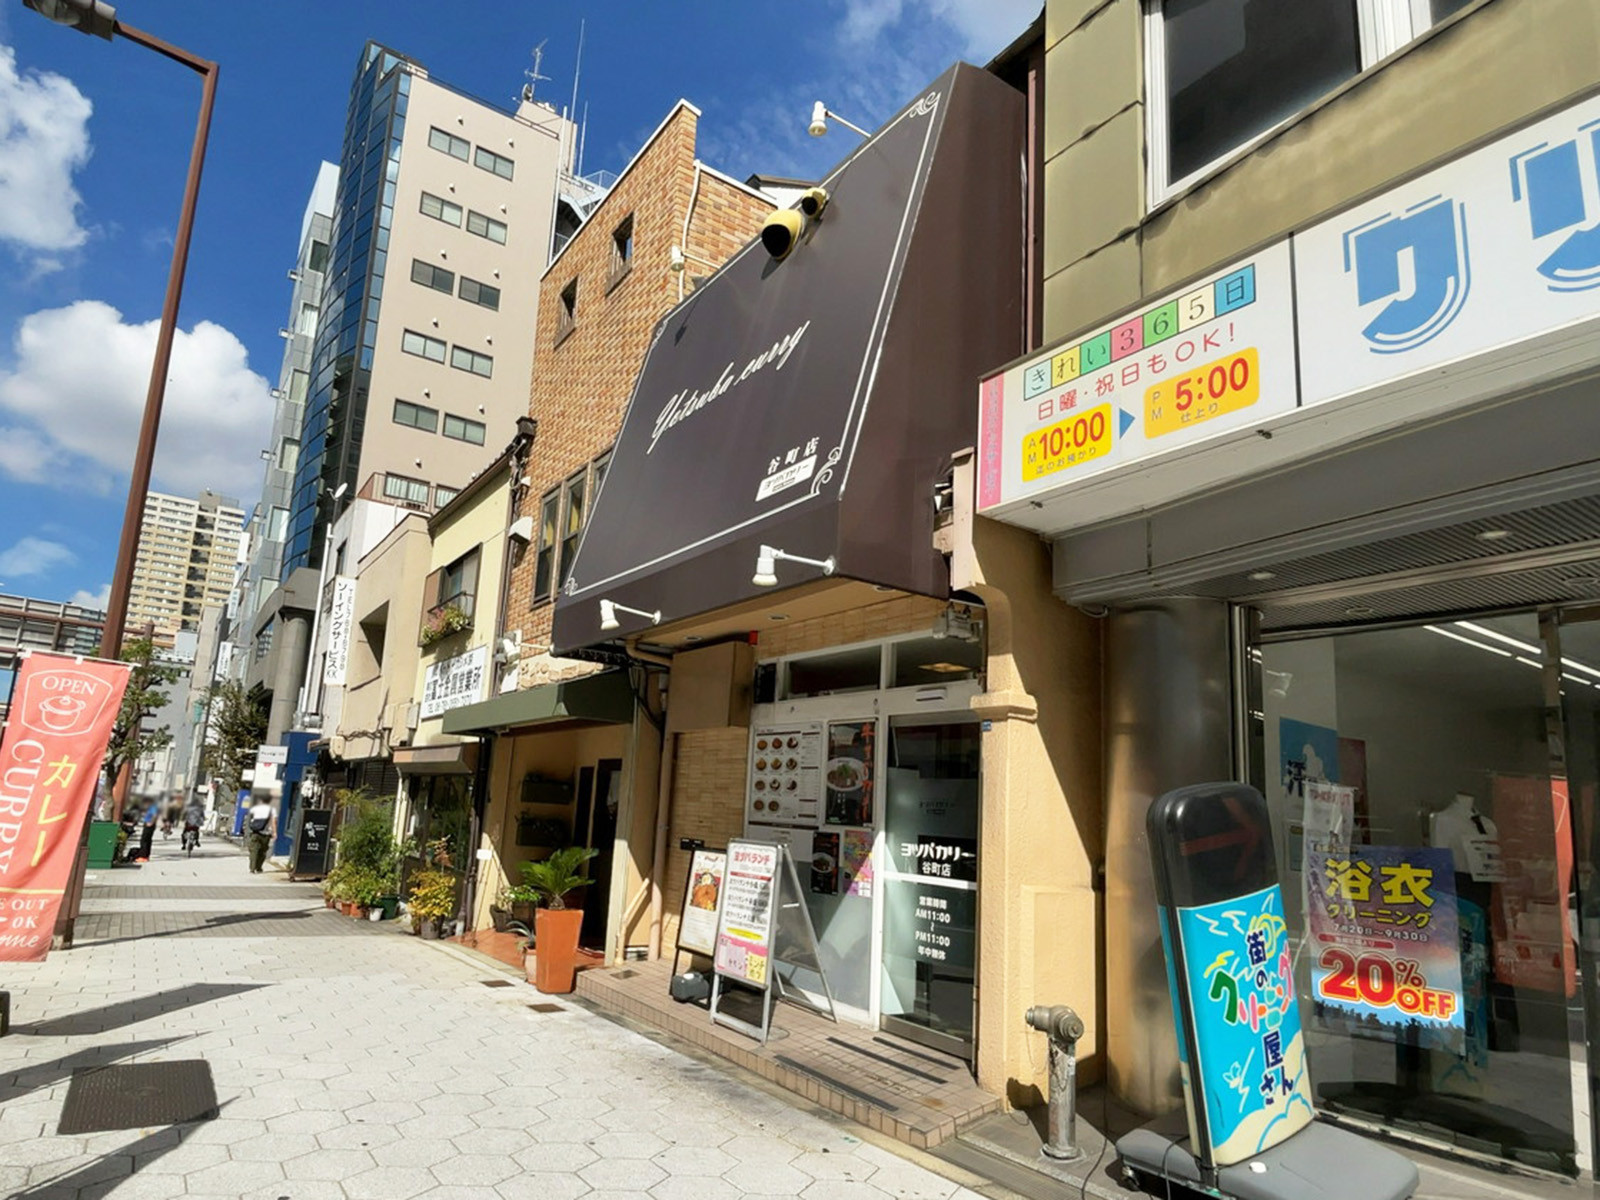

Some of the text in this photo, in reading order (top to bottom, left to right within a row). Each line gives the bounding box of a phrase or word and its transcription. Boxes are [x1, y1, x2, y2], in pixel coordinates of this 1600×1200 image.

[1031, 275, 1245, 391] きれい365日
[733, 320, 811, 385] curry
[1175, 357, 1249, 411] 5:00
[1180, 402, 1218, 423] 仕上り
[1039, 411, 1105, 460] 10:00
[767, 436, 819, 475] 谷町店
[42, 675, 98, 697] OPEN
[30, 754, 78, 867] カレー
[922, 861, 951, 877] 谷町店
[1325, 858, 1435, 909] 浴衣
[11, 898, 49, 912] OUT
[919, 896, 947, 910] 営業時間
[12, 915, 38, 929] OK
[915, 908, 951, 924] AM11:00
[1326, 904, 1432, 929] クリーニング
[915, 930, 951, 947] PM11:00
[918, 945, 946, 961] 年中無休
[1396, 987, 1454, 1017] OFF
